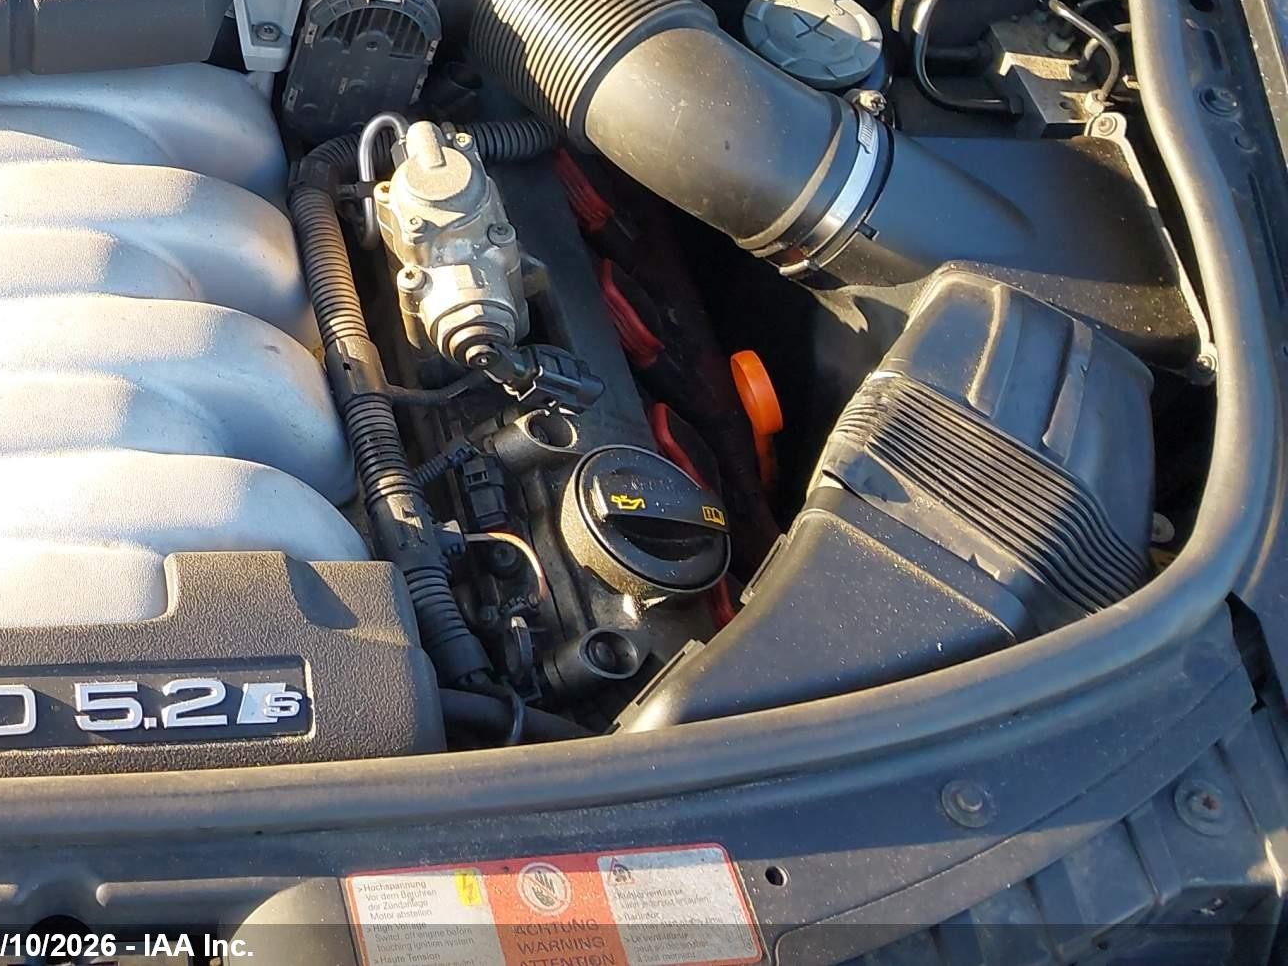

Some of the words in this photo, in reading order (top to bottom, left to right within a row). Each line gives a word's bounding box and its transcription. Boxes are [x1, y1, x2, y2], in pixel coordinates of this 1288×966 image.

[74, 678, 229, 731] 5.2
[364, 880, 426, 893] Hochspannung
[370, 912, 395, 921] Motor
[373, 923, 392, 934] High
[513, 918, 599, 936] ACHTUNG
[516, 936, 606, 954] WARNING
